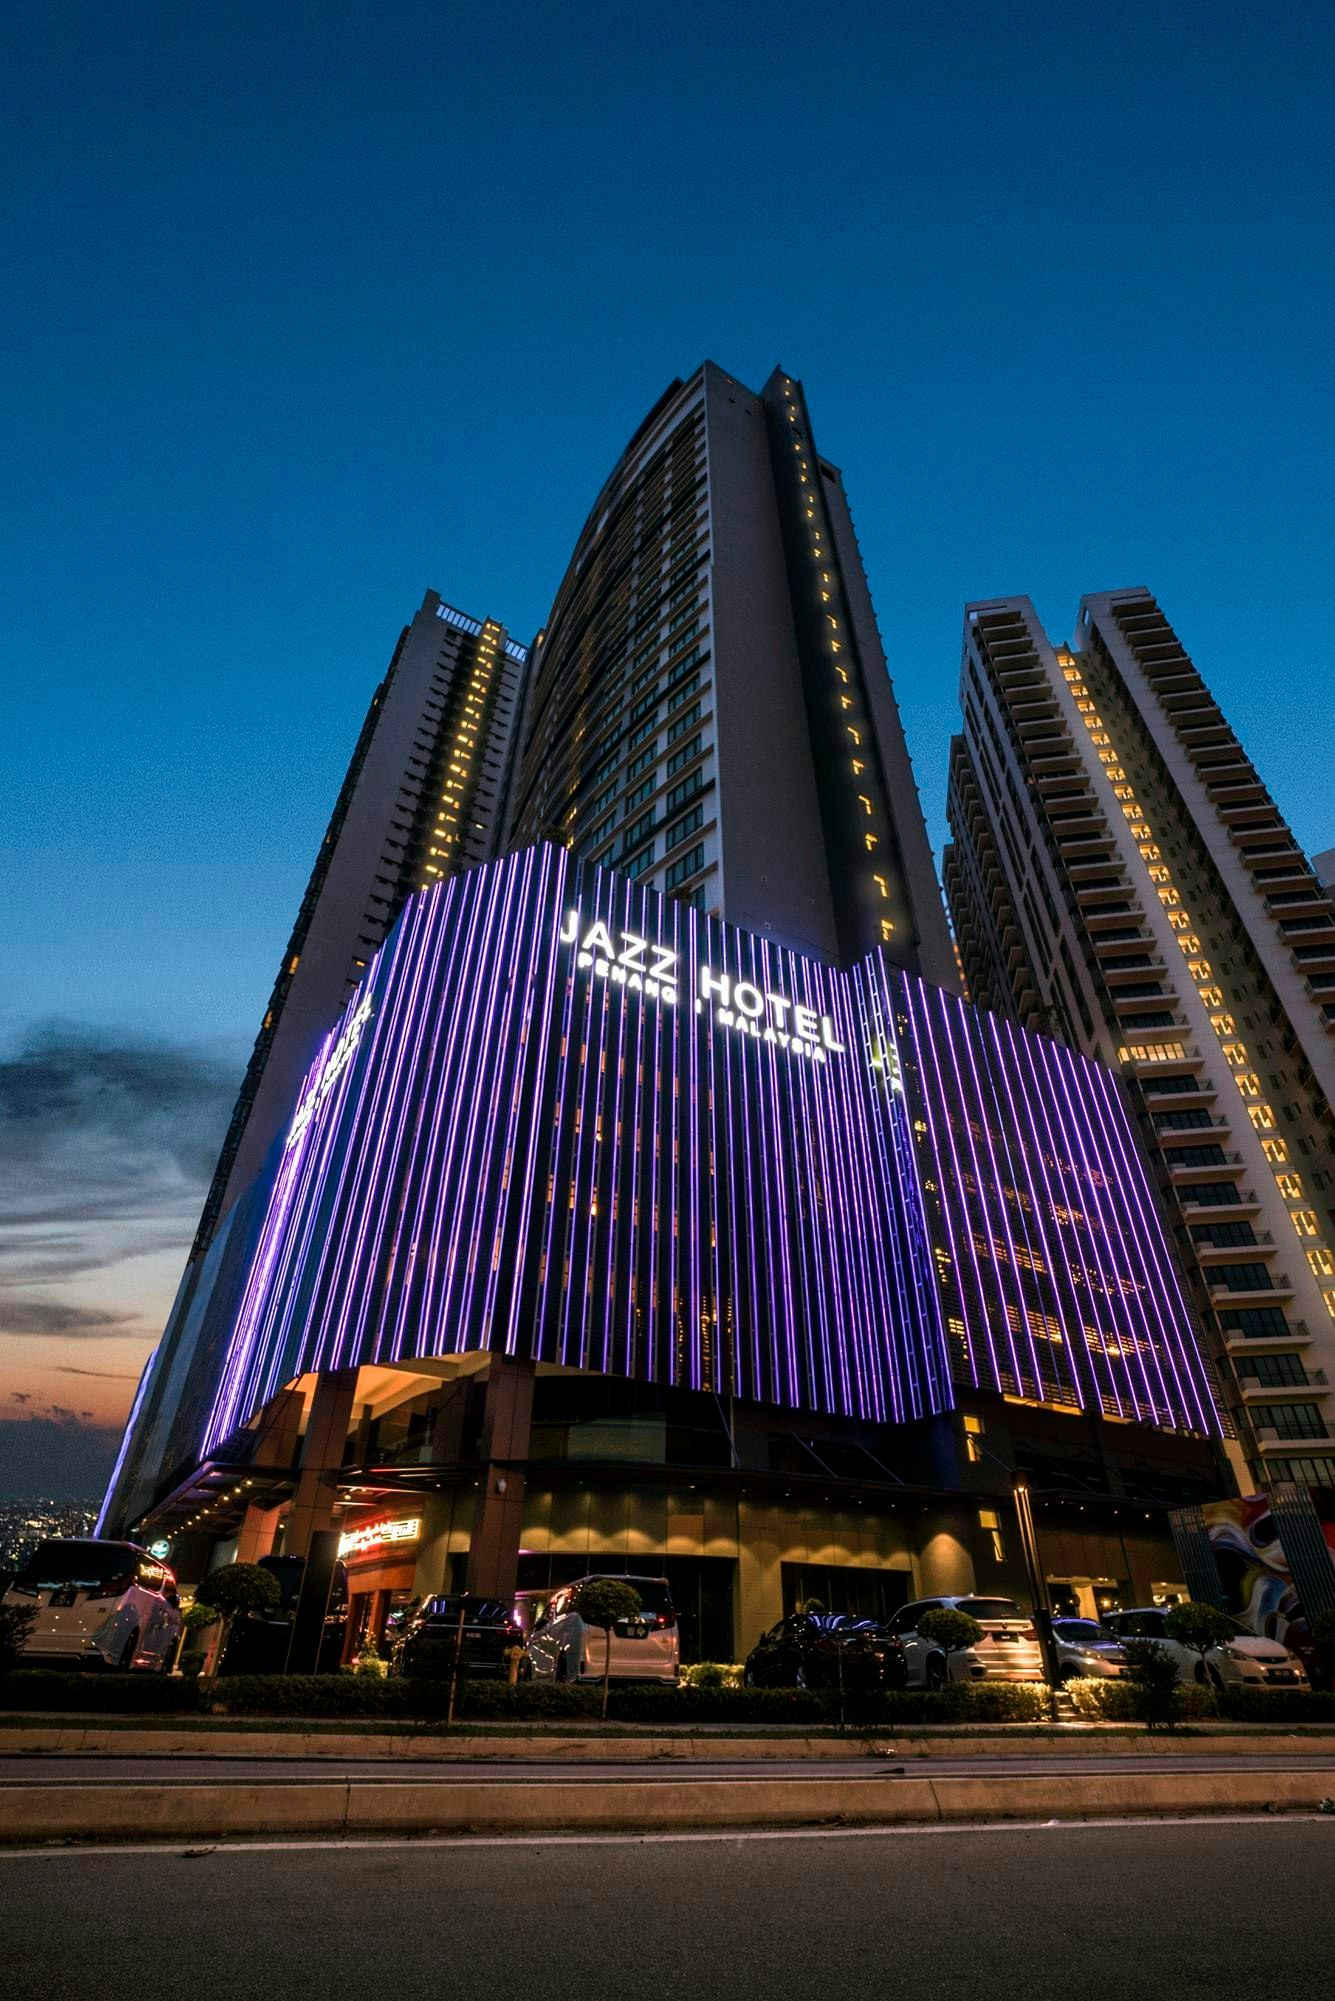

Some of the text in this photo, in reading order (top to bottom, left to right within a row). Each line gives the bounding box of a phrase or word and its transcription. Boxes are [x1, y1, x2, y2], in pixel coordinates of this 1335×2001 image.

[560, 910, 845, 1053] JAZZ HOTEL
[577, 952, 678, 1004] PENANG
[717, 1008, 826, 1063] MALAYSIA
